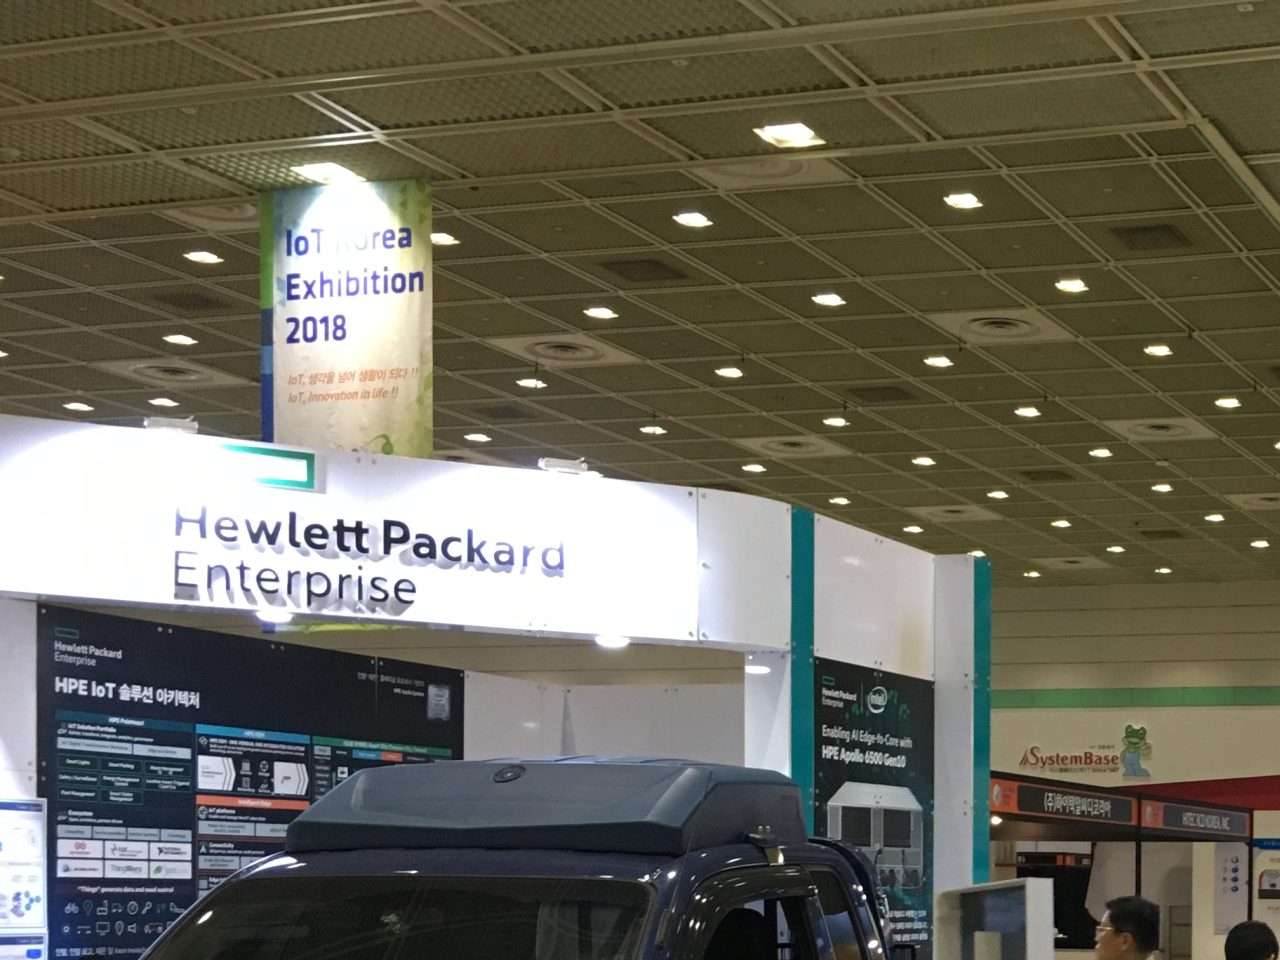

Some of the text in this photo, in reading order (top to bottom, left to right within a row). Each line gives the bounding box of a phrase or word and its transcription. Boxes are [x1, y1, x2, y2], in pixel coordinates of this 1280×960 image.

[286, 228, 323, 257] IoT
[286, 266, 424, 301] Exhibition
[286, 314, 347, 344] 2018
[307, 390, 359, 402] Innovation
[360, 389, 370, 400] in
[372, 387, 389, 399] life
[175, 504, 564, 570] Hewlett Packard
[174, 550, 416, 606] Enterprise
[54, 640, 123, 659] Hewlett Packard
[54, 652, 96, 666] Enterprise
[55, 676, 200, 709] HPE IoT 솔루션 아키텍처
[822, 724, 850, 742] Enabling
[822, 745, 907, 768] HPE Apollo 6500 Gen10
[1026, 746, 1119, 769] SystemBase
